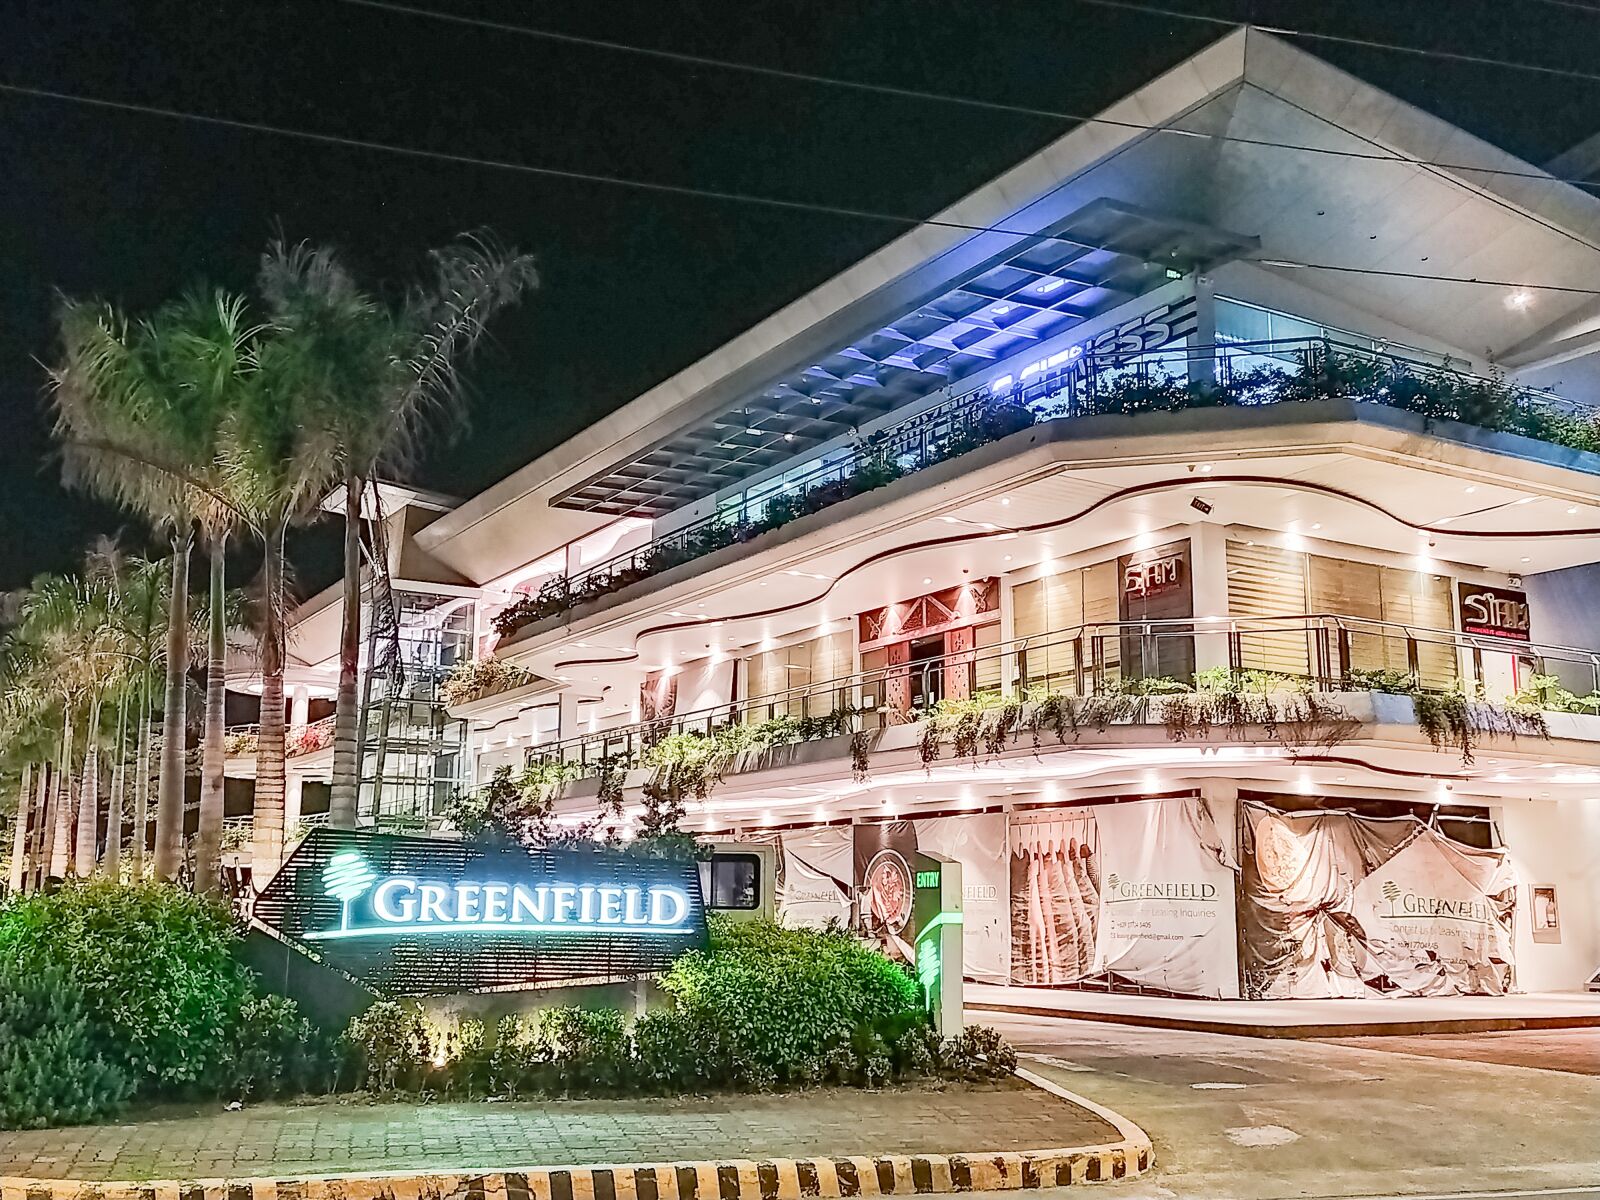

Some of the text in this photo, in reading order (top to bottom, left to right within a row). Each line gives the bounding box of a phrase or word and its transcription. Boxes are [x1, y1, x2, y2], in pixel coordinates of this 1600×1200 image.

[916, 871, 939, 888] ENTRY
[1120, 882, 1216, 898] GREENFIELD
[373, 879, 687, 926] GREENFIELD
